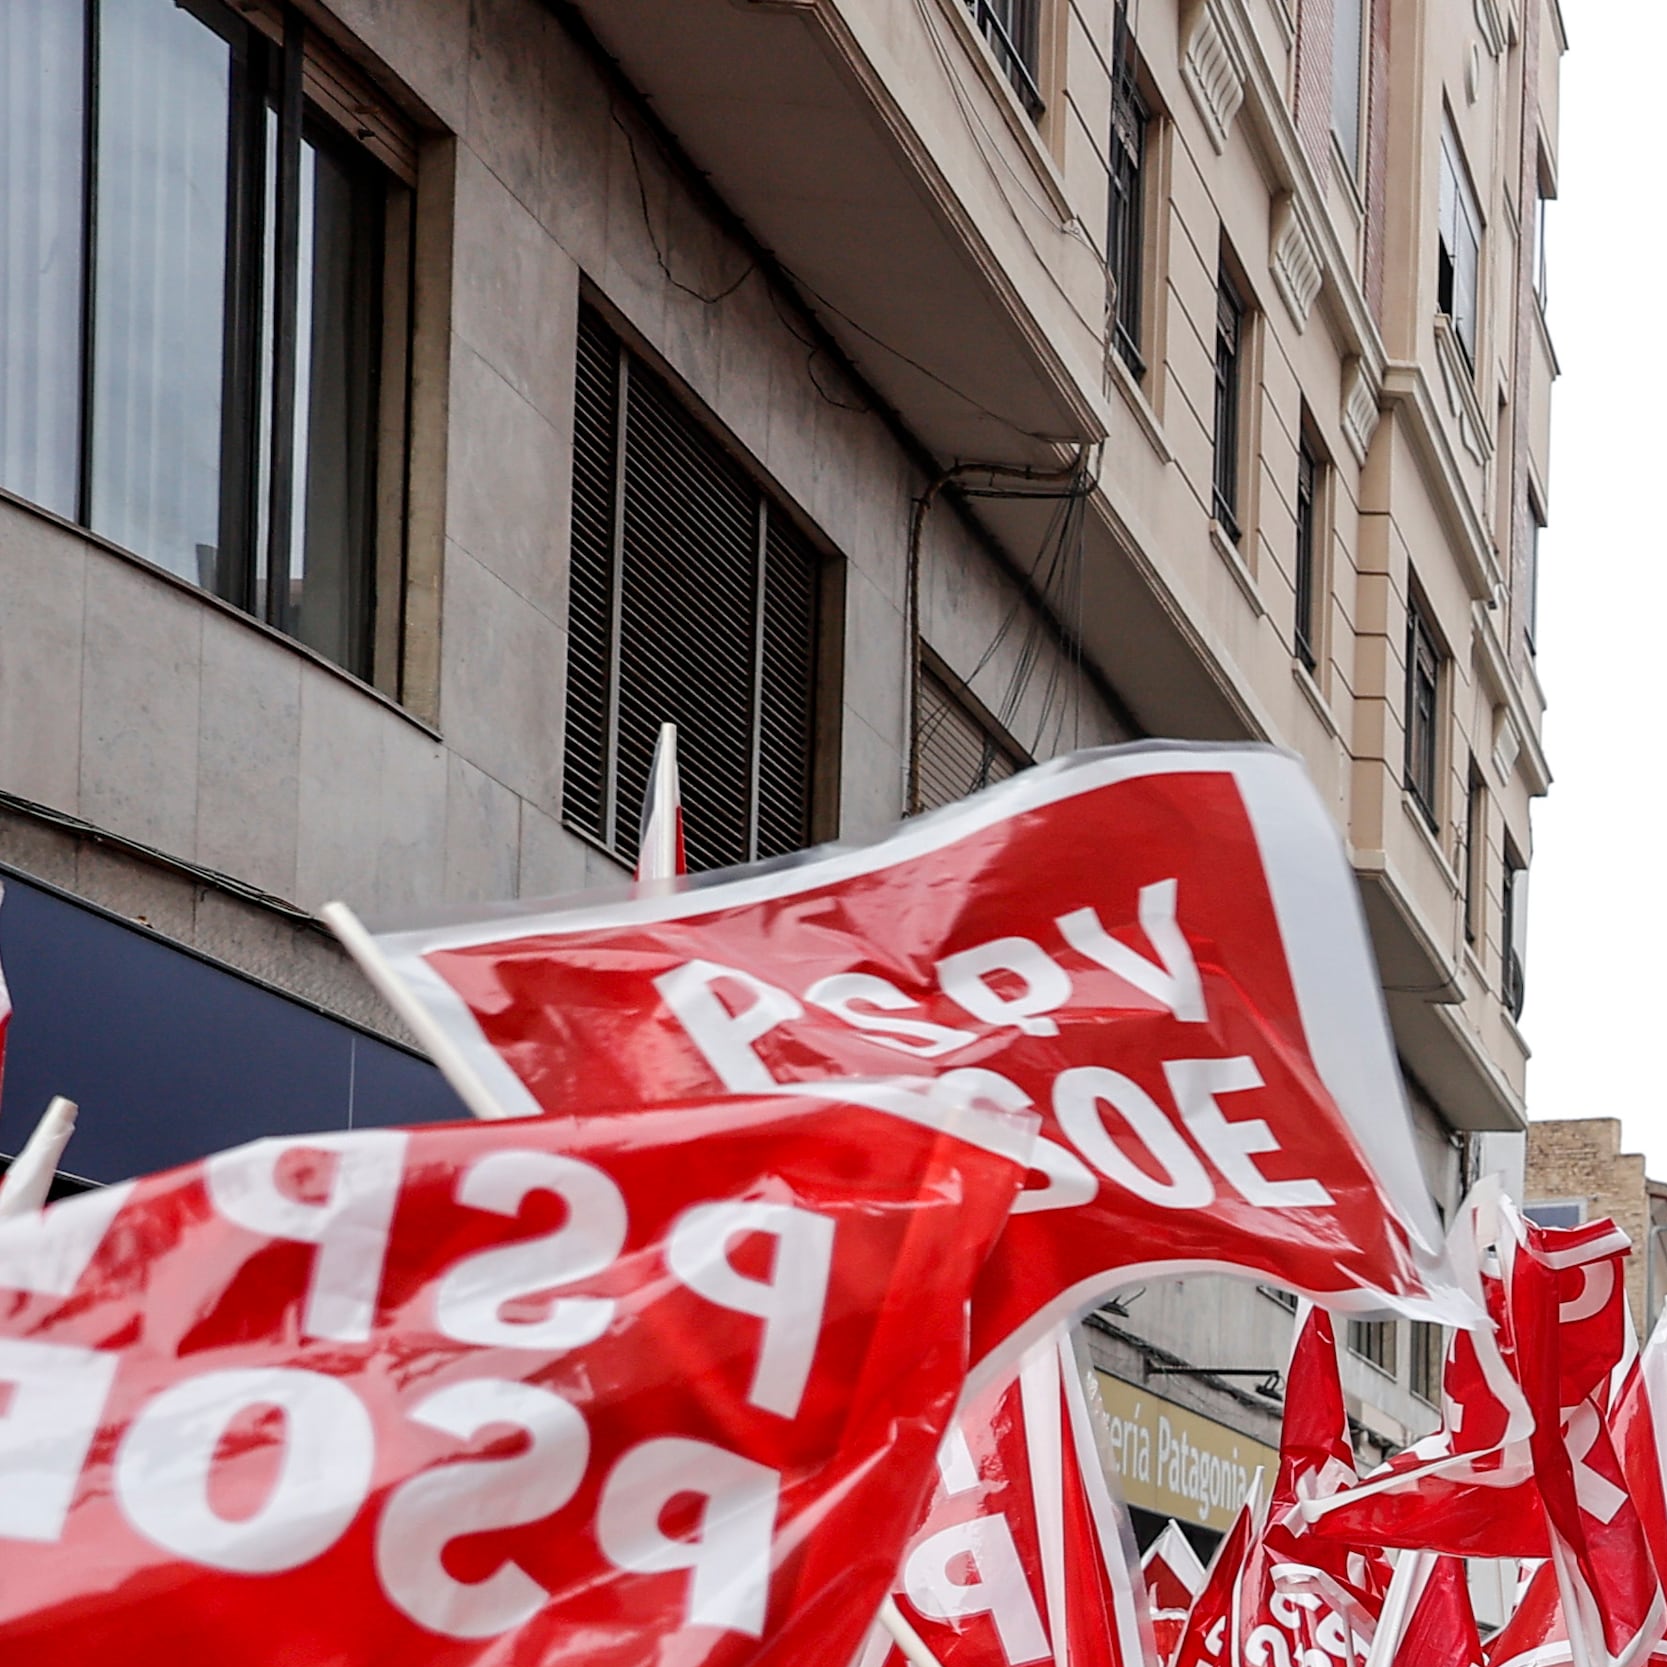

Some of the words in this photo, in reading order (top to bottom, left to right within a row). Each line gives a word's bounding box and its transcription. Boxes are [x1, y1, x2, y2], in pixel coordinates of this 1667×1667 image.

[928, 1054, 1336, 1215] SOE
[1103, 1402, 1150, 1484] ería
[1156, 1415, 1250, 1522] Patagonia
